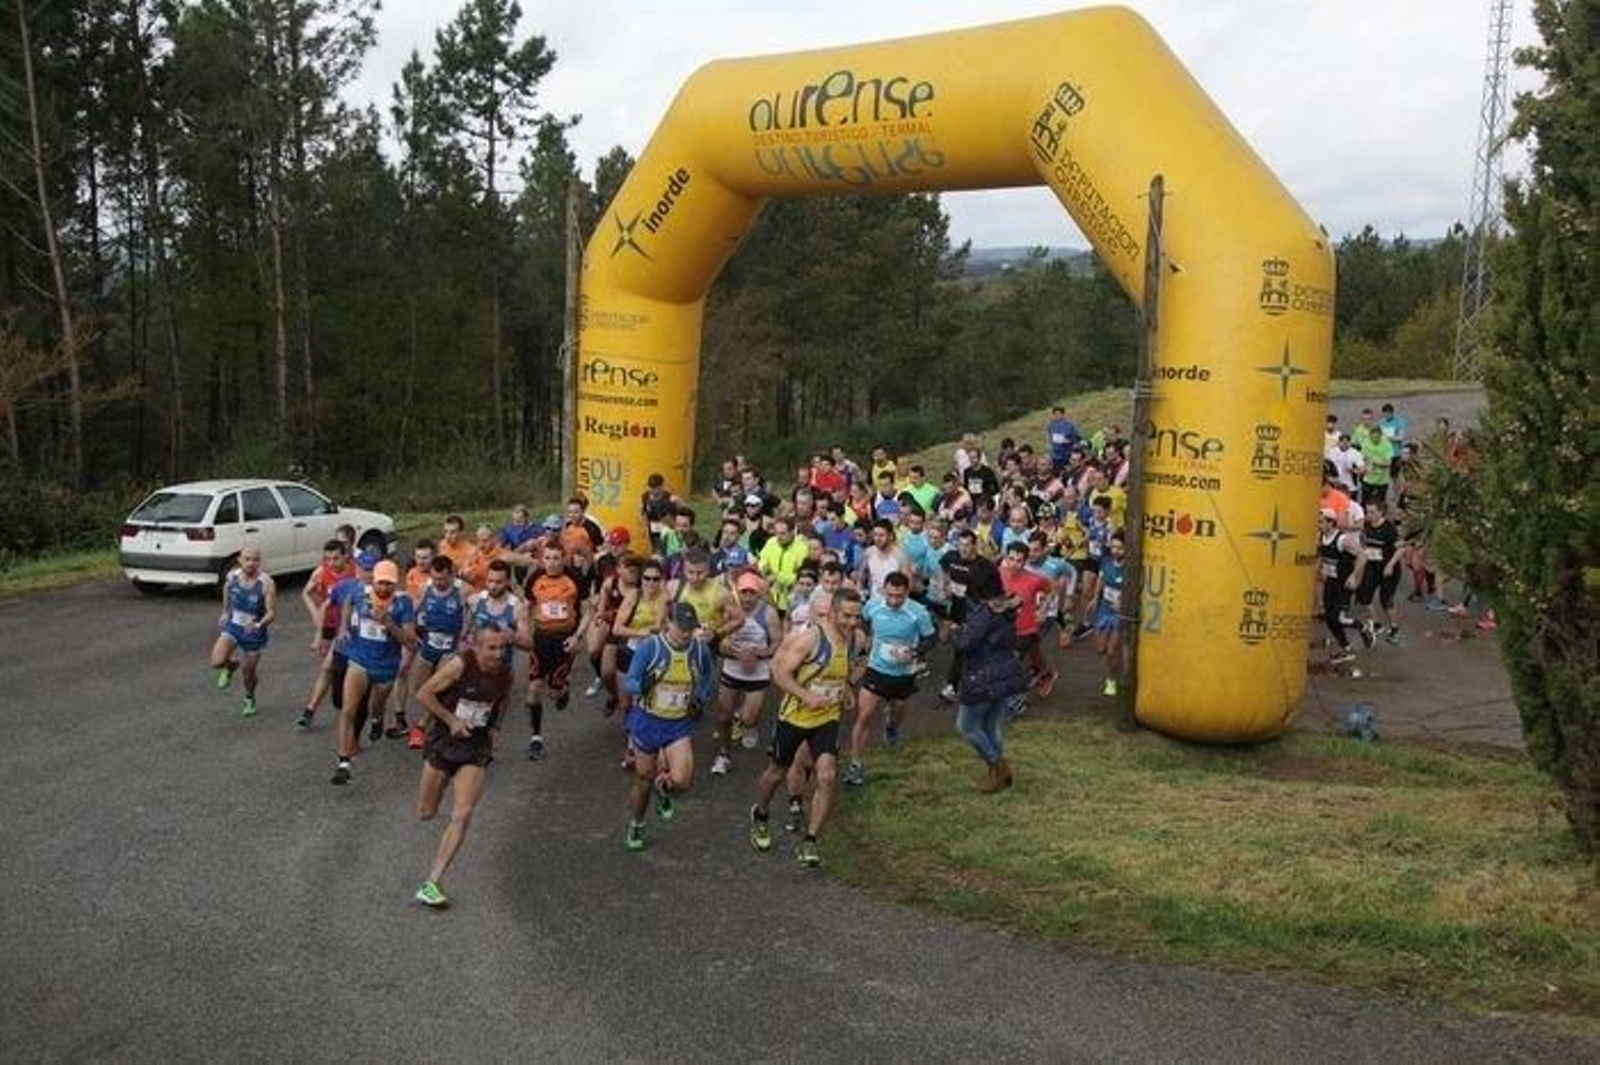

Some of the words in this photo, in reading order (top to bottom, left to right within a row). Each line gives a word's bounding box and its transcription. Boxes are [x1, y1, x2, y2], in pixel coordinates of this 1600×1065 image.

[749, 70, 934, 131] ourense
[641, 167, 691, 234] inorde
[1152, 364, 1210, 381] norde
